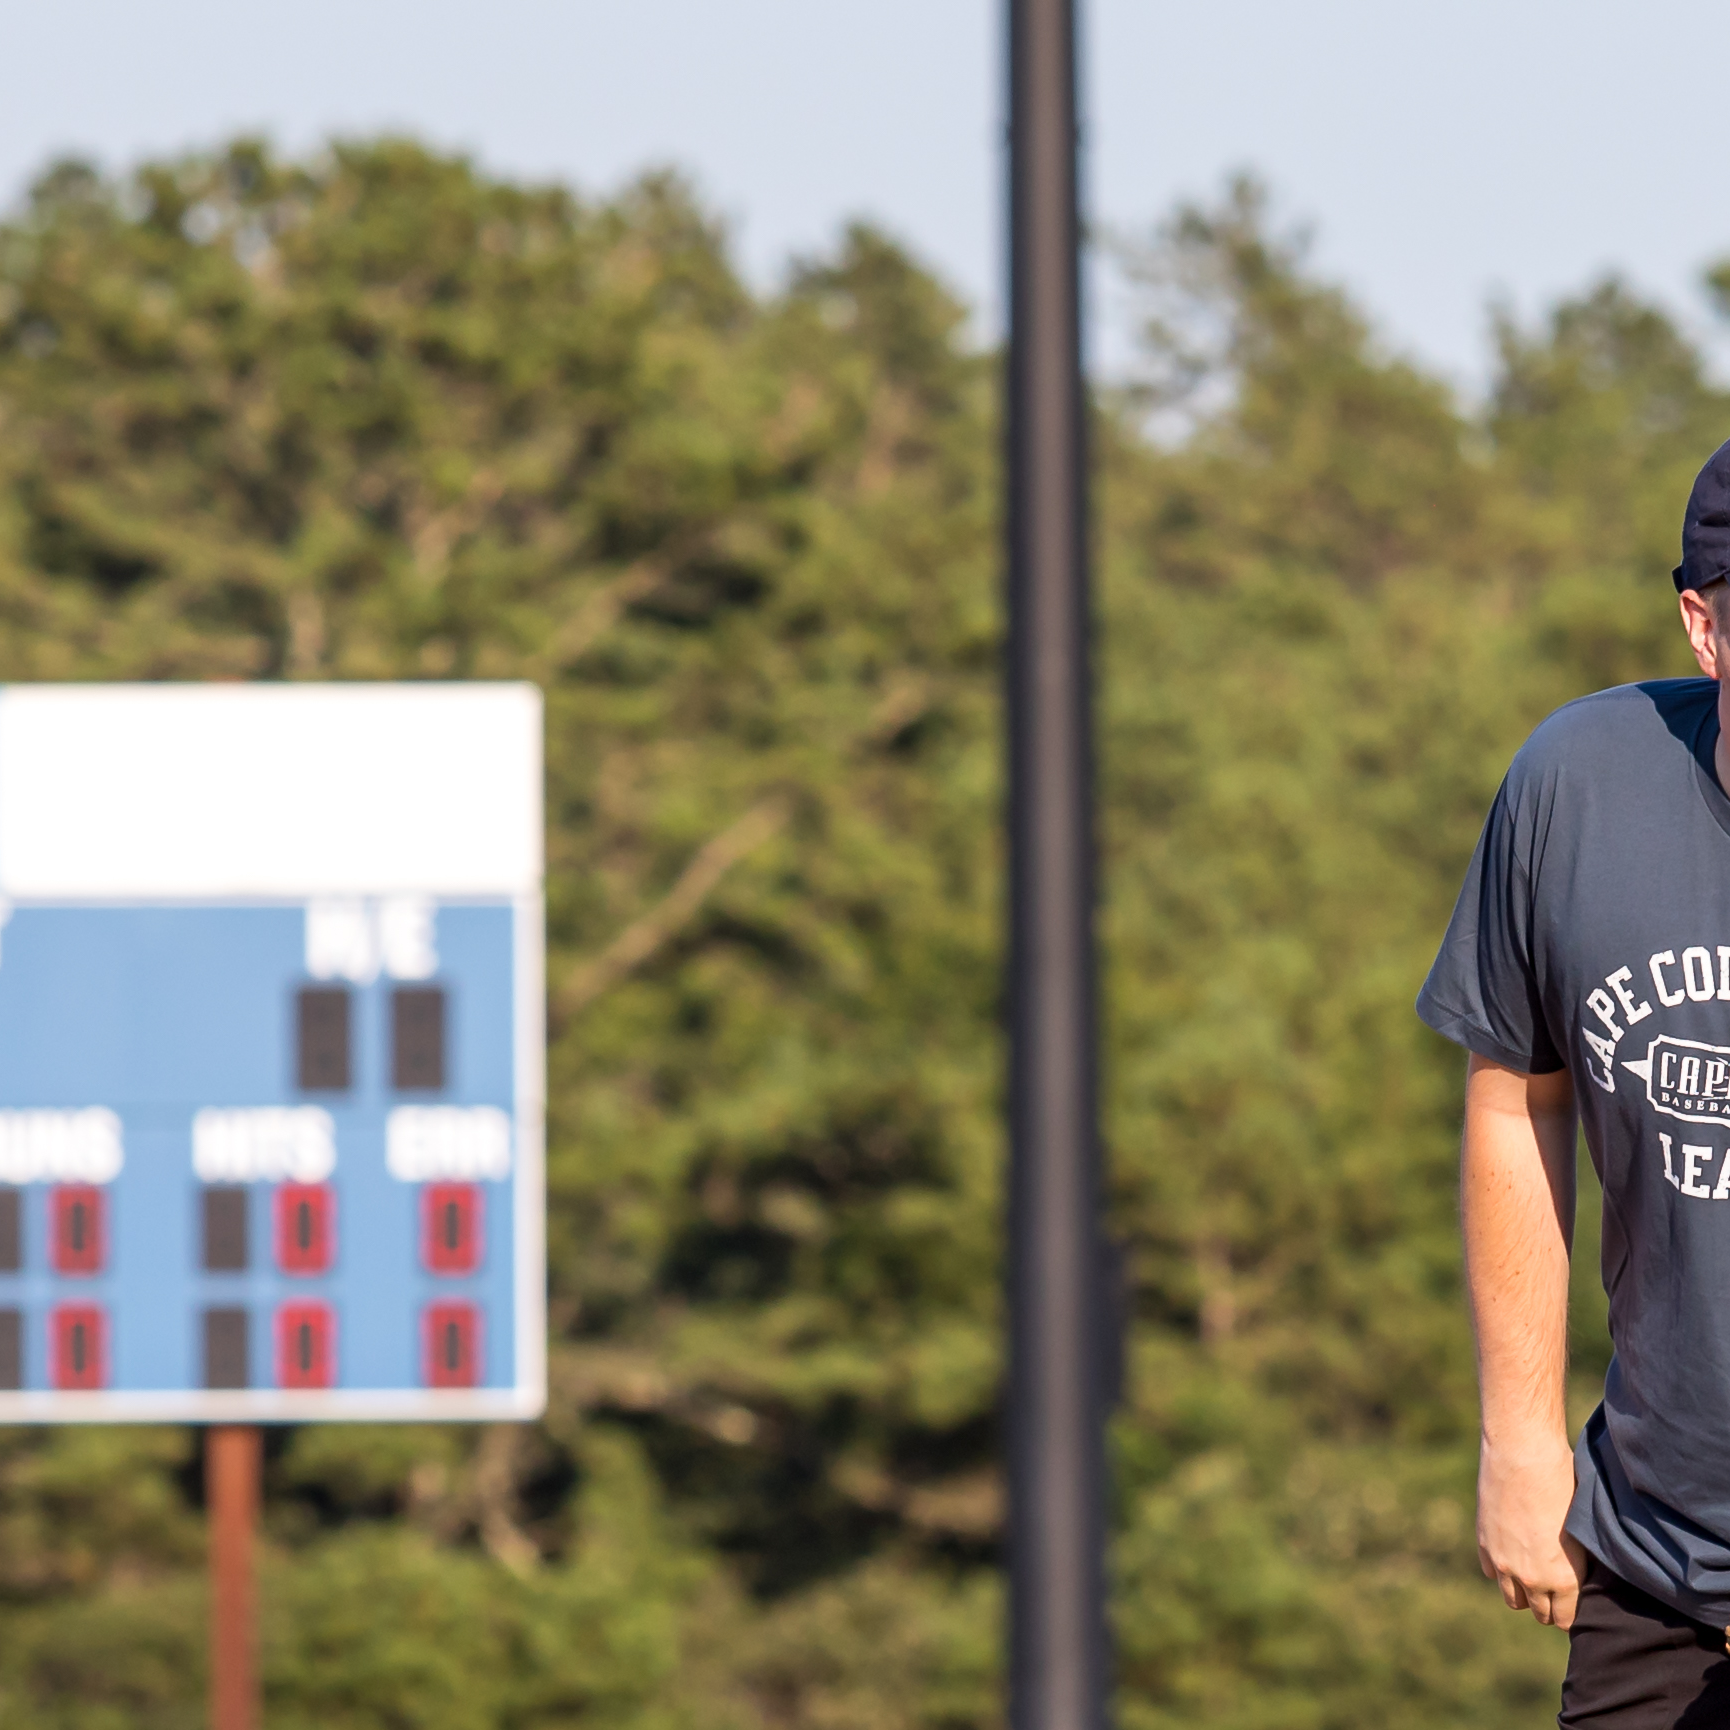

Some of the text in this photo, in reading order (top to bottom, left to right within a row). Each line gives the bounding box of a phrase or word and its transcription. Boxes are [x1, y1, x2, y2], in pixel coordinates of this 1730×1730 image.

[1583, 965, 1653, 1093] CAPE
[47, 1180, 109, 1280] 0
[275, 1180, 337, 1280] 0
[419, 1180, 481, 1280] 0
